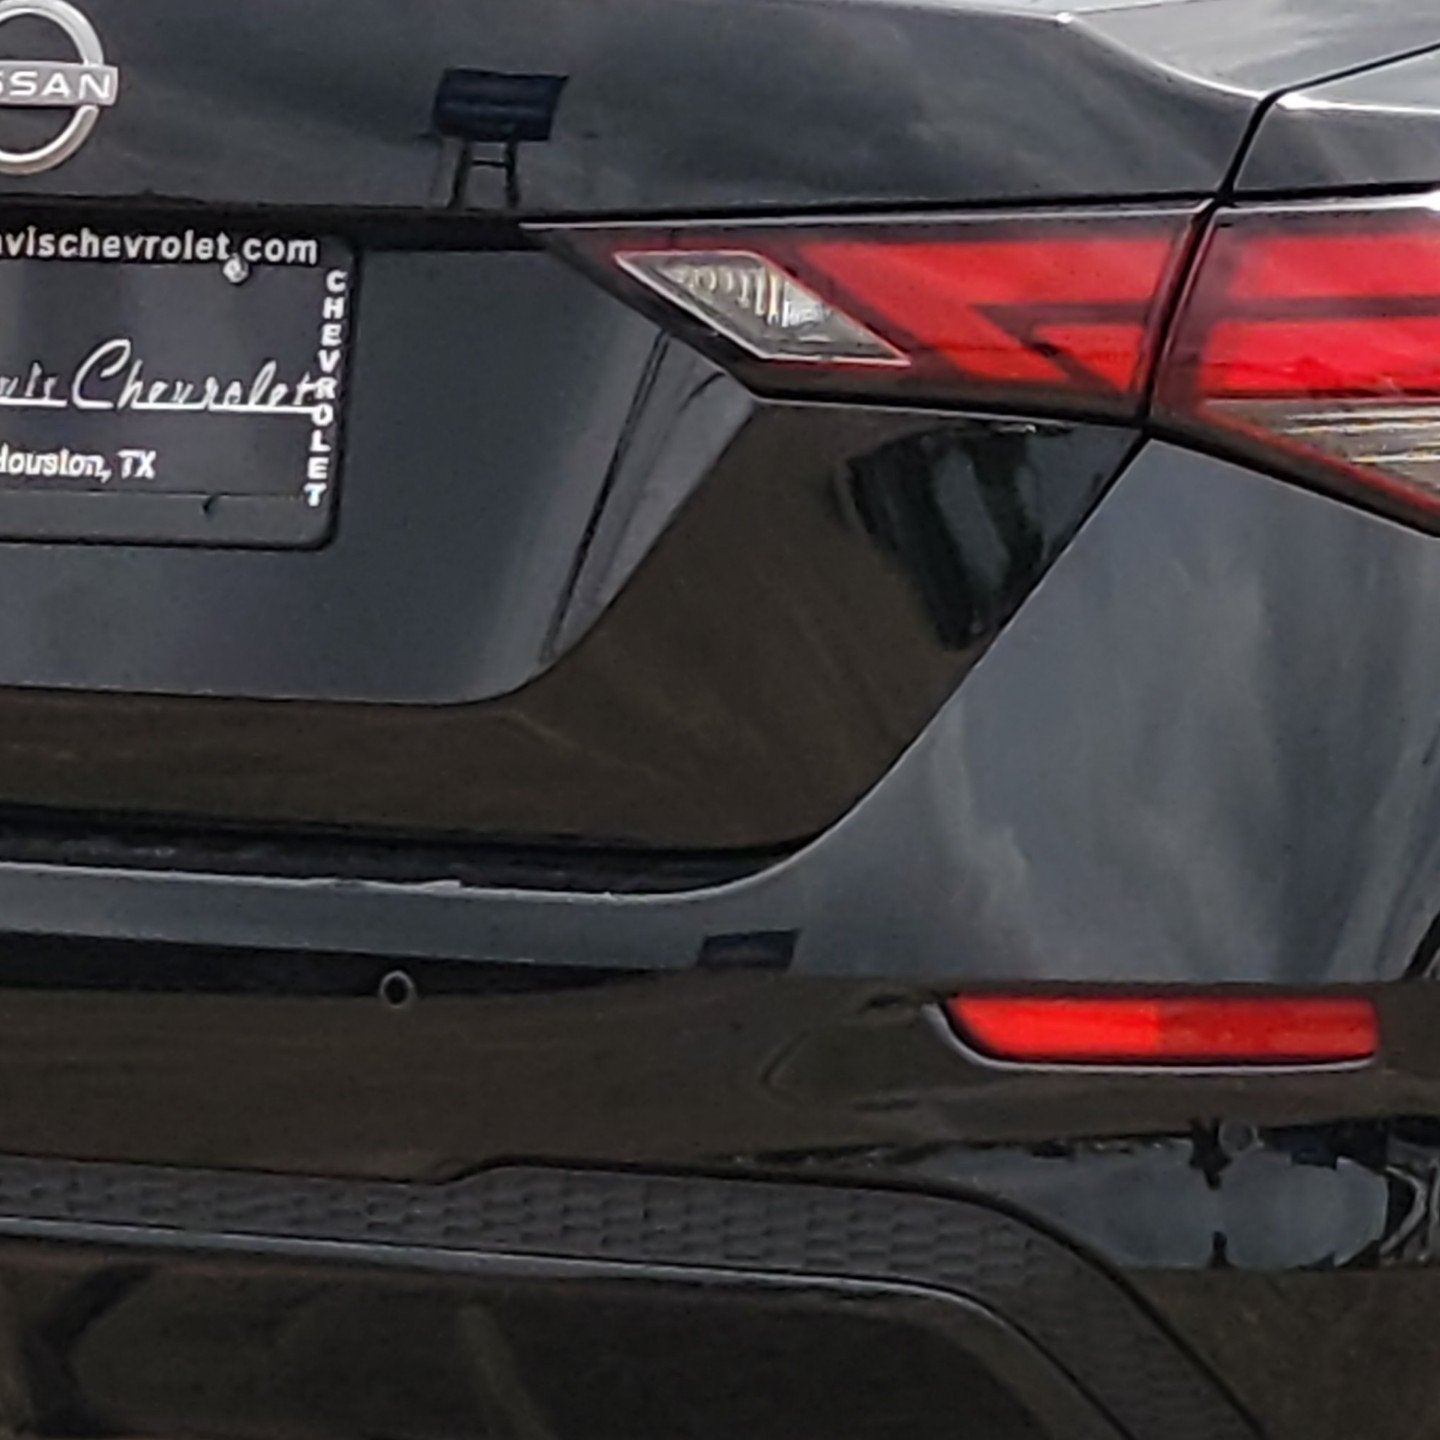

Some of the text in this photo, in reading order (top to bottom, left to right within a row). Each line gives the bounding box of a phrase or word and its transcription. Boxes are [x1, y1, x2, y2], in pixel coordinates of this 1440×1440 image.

[71, 338, 320, 414] Chevrolet
[303, 269, 348, 507] CHEVROLET
[118, 448, 157, 480] TX
